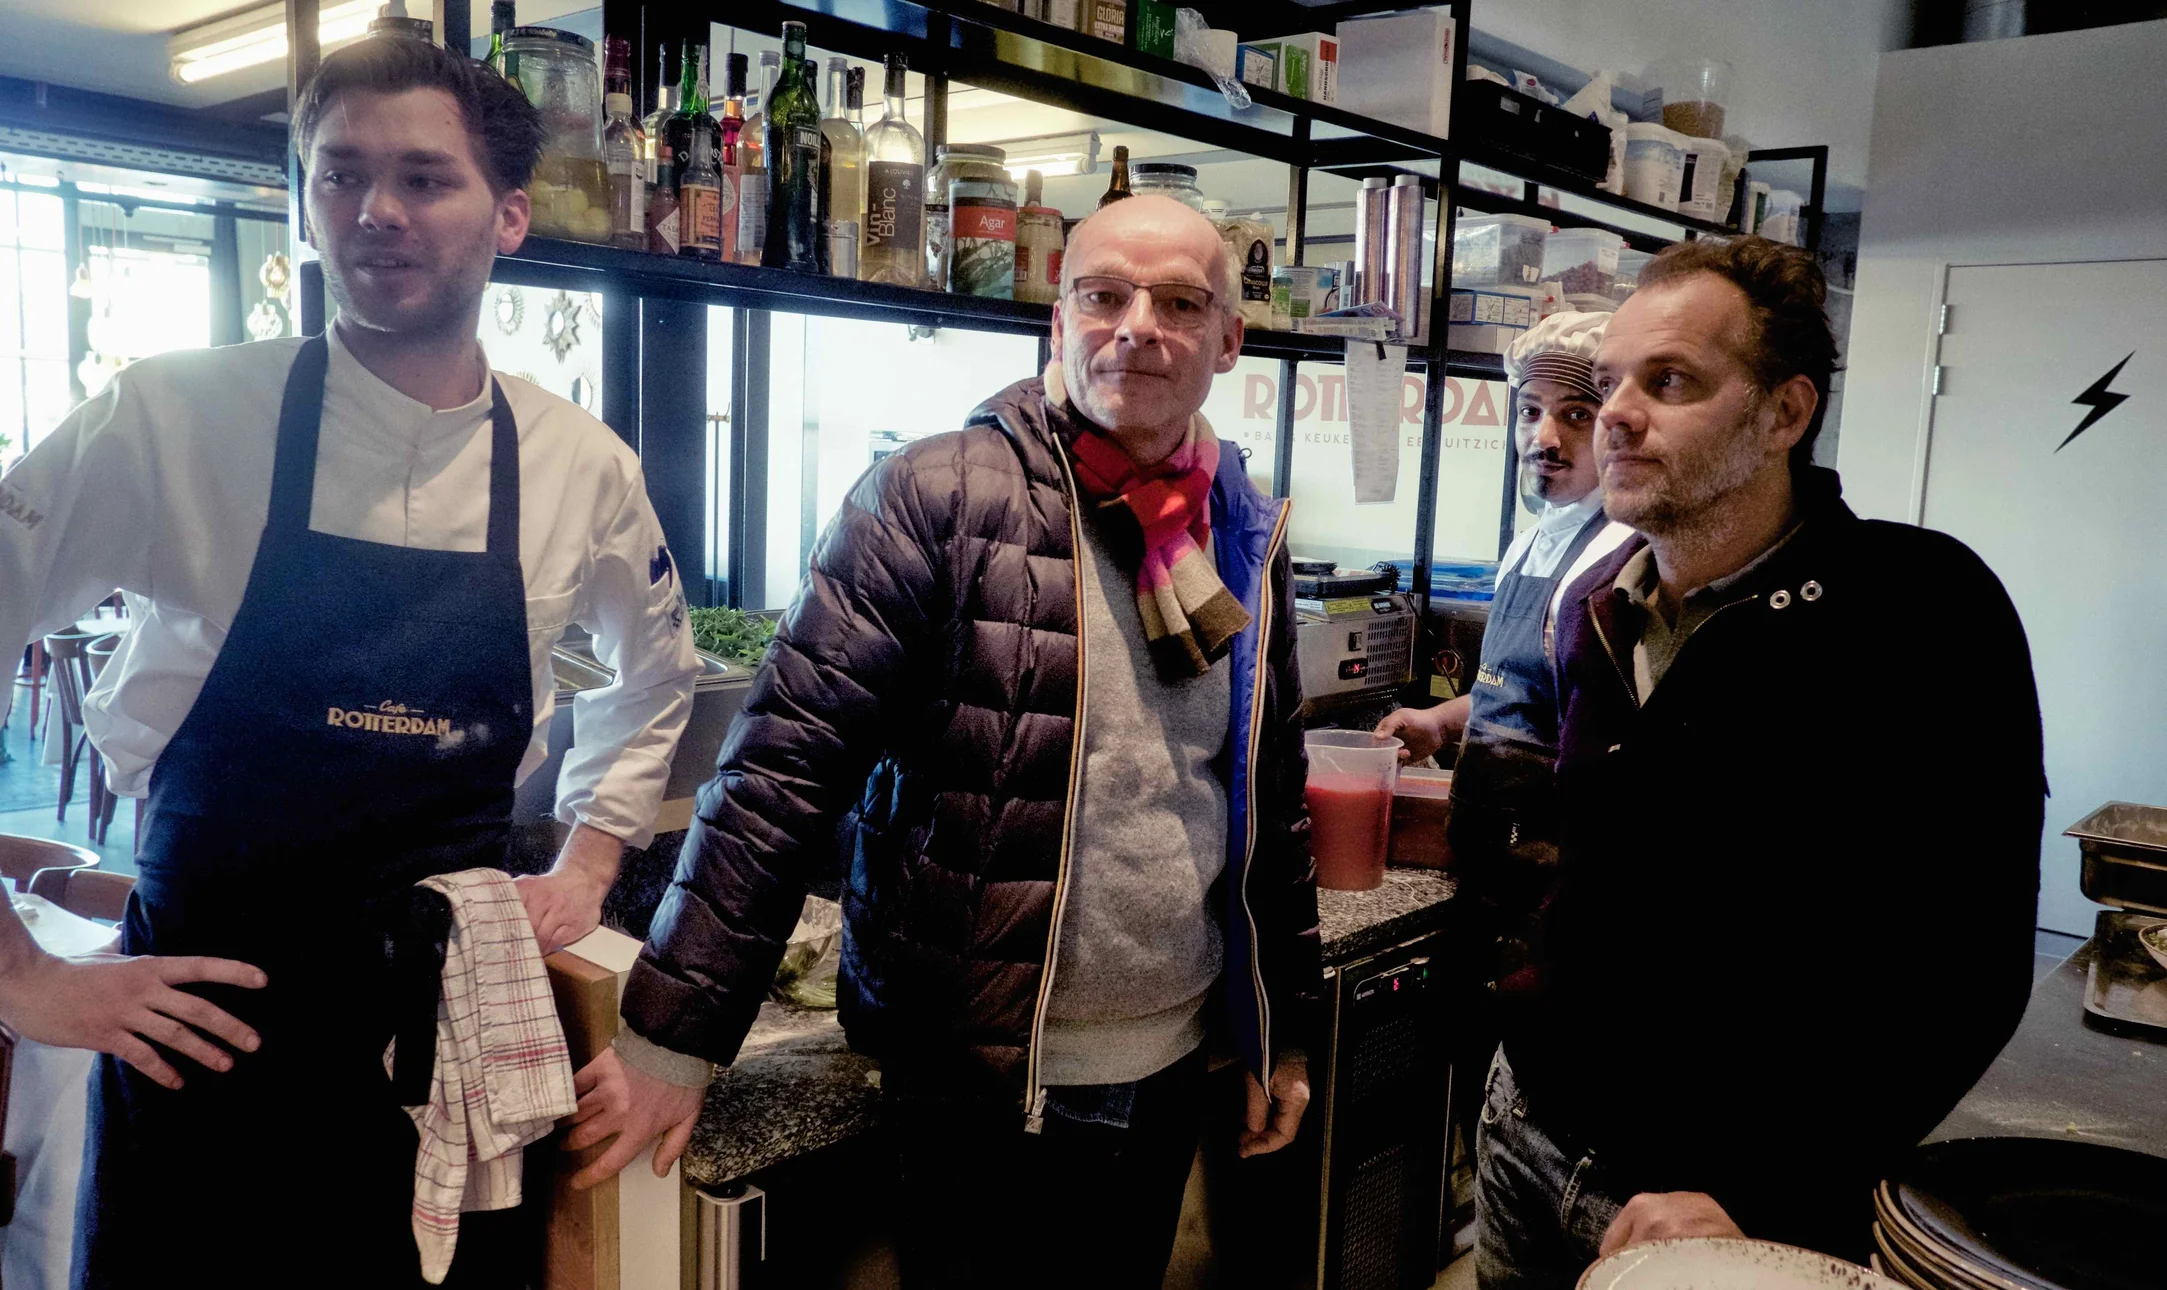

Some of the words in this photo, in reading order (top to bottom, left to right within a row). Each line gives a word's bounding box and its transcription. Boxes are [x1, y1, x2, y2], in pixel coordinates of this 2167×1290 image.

[1096, 5, 1125, 25] GLORIA
[879, 188, 897, 237] Blanc
[979, 215, 1006, 231] Agar
[1243, 373, 1508, 426] ROTTRDA
[1304, 433, 1351, 444] KEUKE
[327, 706, 451, 736] ROTTERDAM
